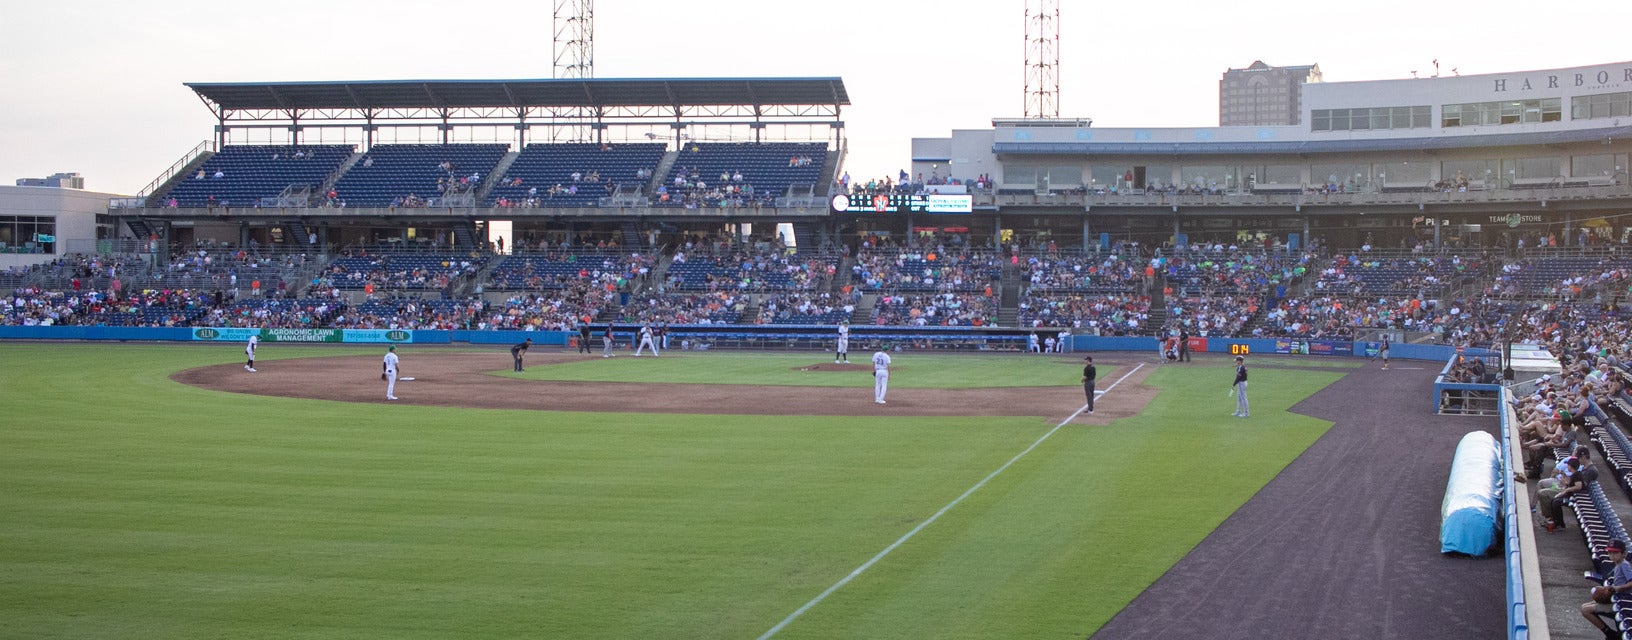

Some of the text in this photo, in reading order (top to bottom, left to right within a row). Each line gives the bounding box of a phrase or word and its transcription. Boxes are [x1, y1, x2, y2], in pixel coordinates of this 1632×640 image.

[1494, 68, 1632, 92] HARBOR
[200, 330, 214, 338] ALM
[391, 332, 404, 340] ALM
